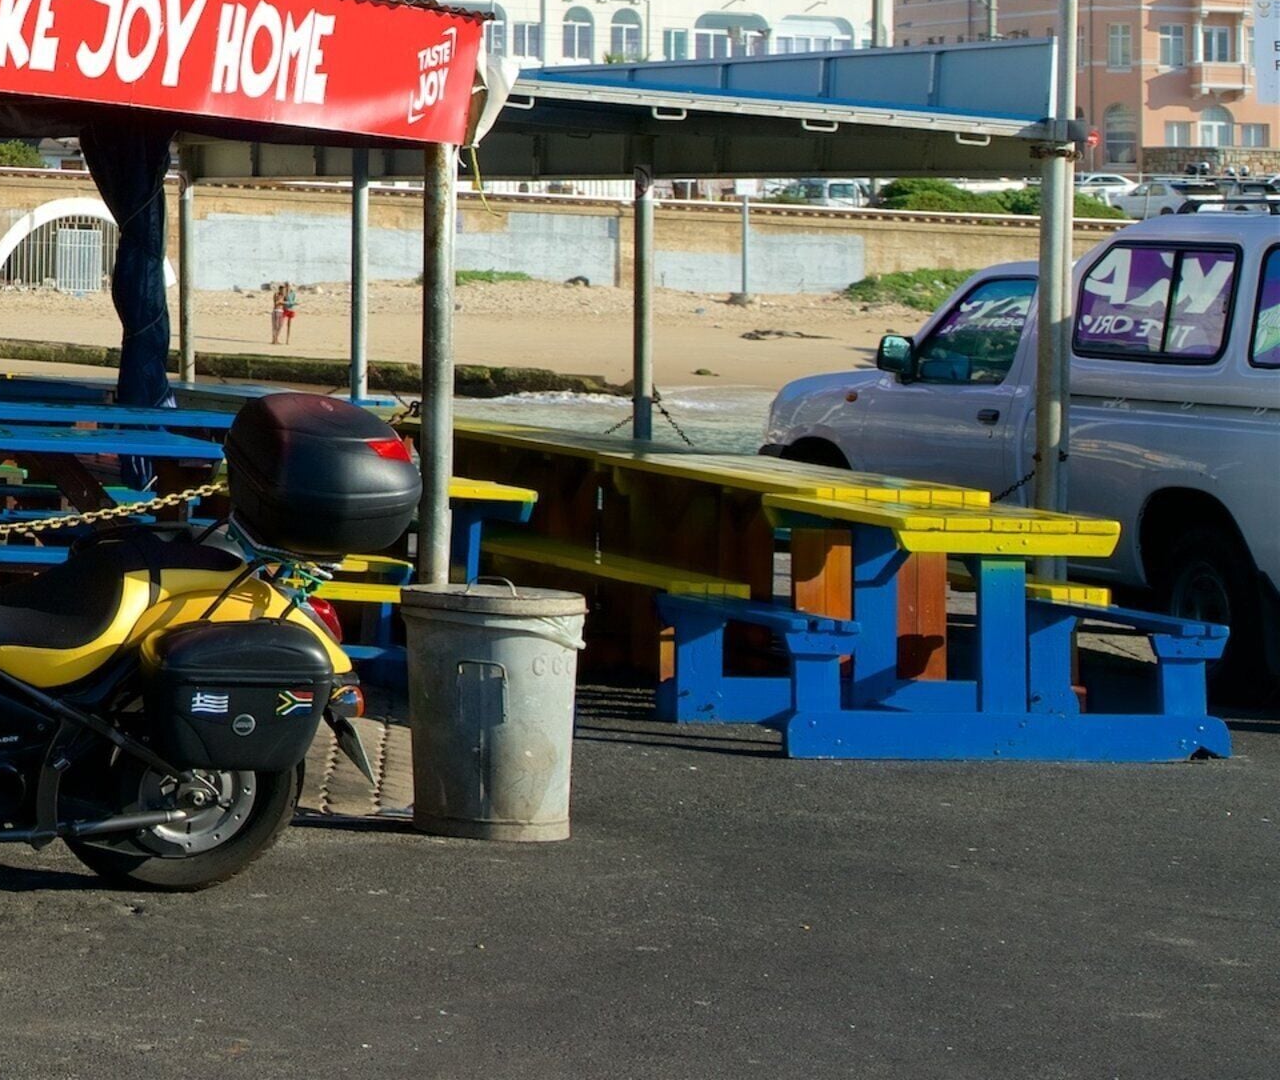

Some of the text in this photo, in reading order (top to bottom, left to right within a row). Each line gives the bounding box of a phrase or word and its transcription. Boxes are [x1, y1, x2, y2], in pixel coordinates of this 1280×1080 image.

[211, 1, 337, 107] HOME
[418, 40, 451, 71] TASTE
[414, 67, 449, 110] JOY
